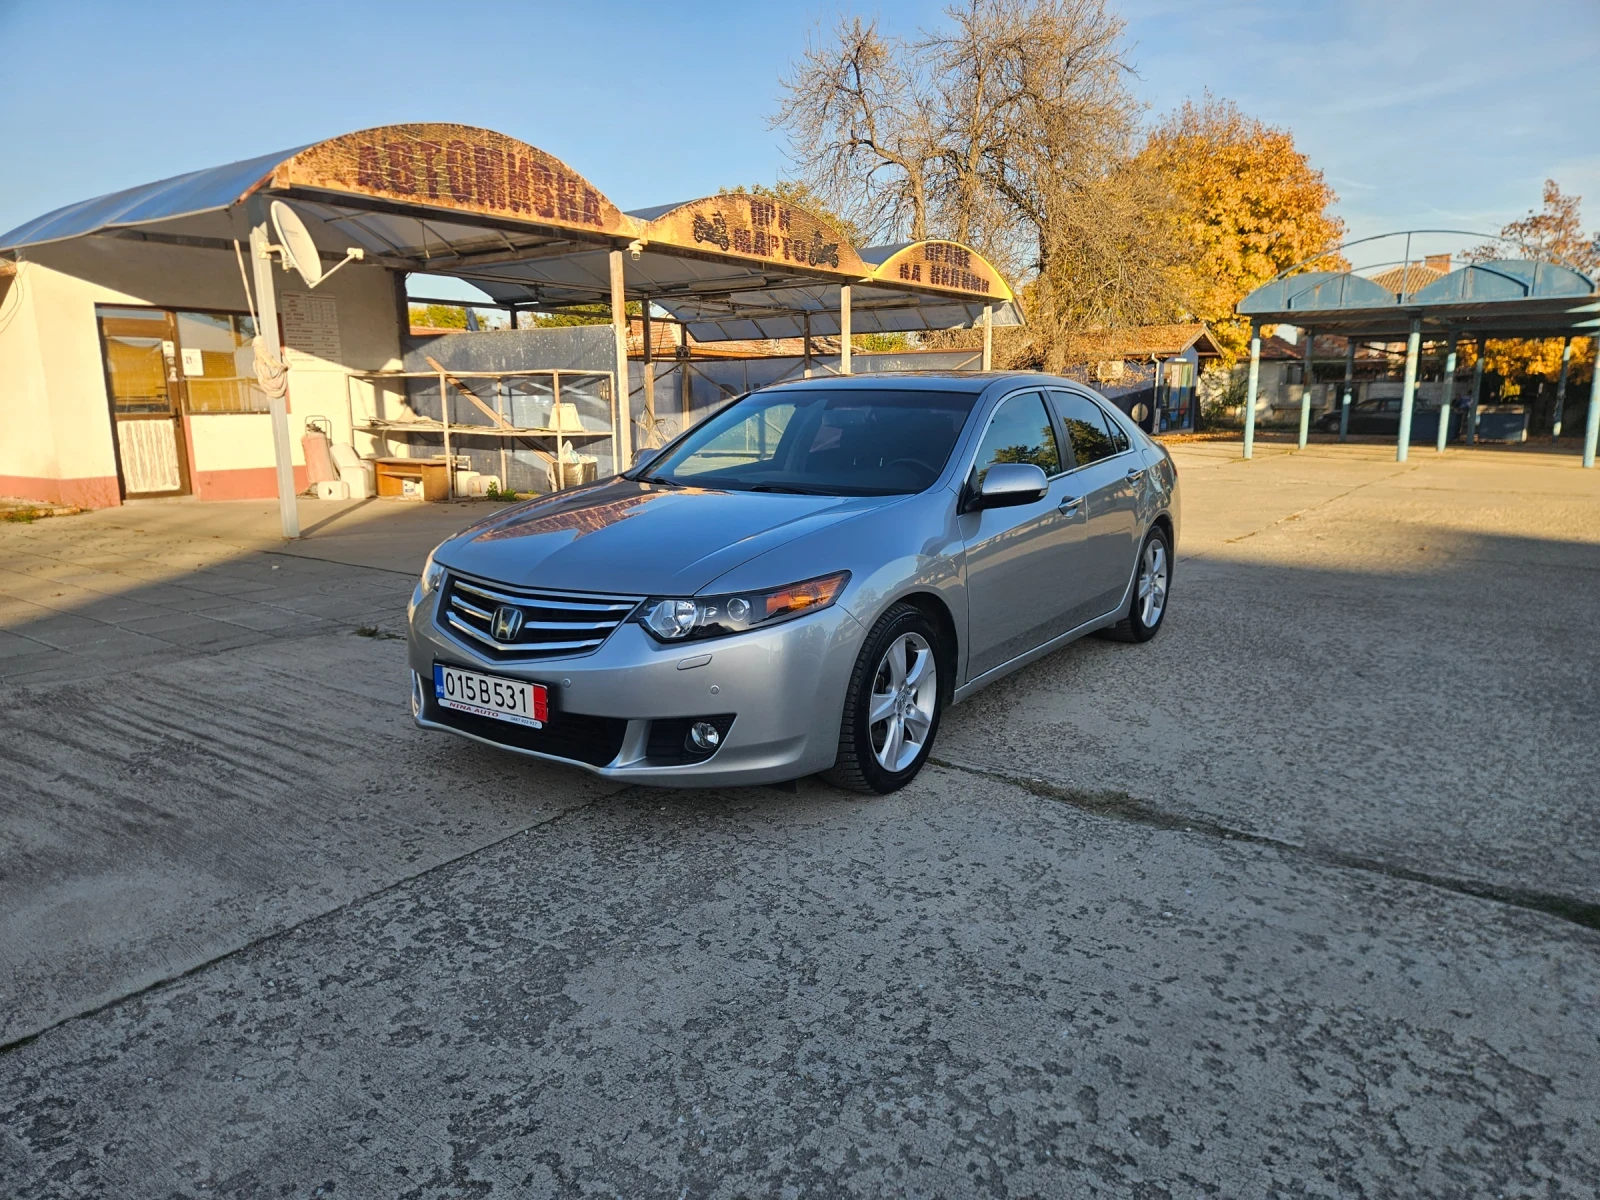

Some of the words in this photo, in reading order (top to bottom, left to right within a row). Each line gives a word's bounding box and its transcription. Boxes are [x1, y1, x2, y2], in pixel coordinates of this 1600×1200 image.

[357, 139, 604, 227] АВТОМИВКА
[899, 262, 922, 282] НА
[445, 672, 527, 713] 015B531
[449, 702, 472, 712] NINA
[474, 708, 499, 718] AUTO
